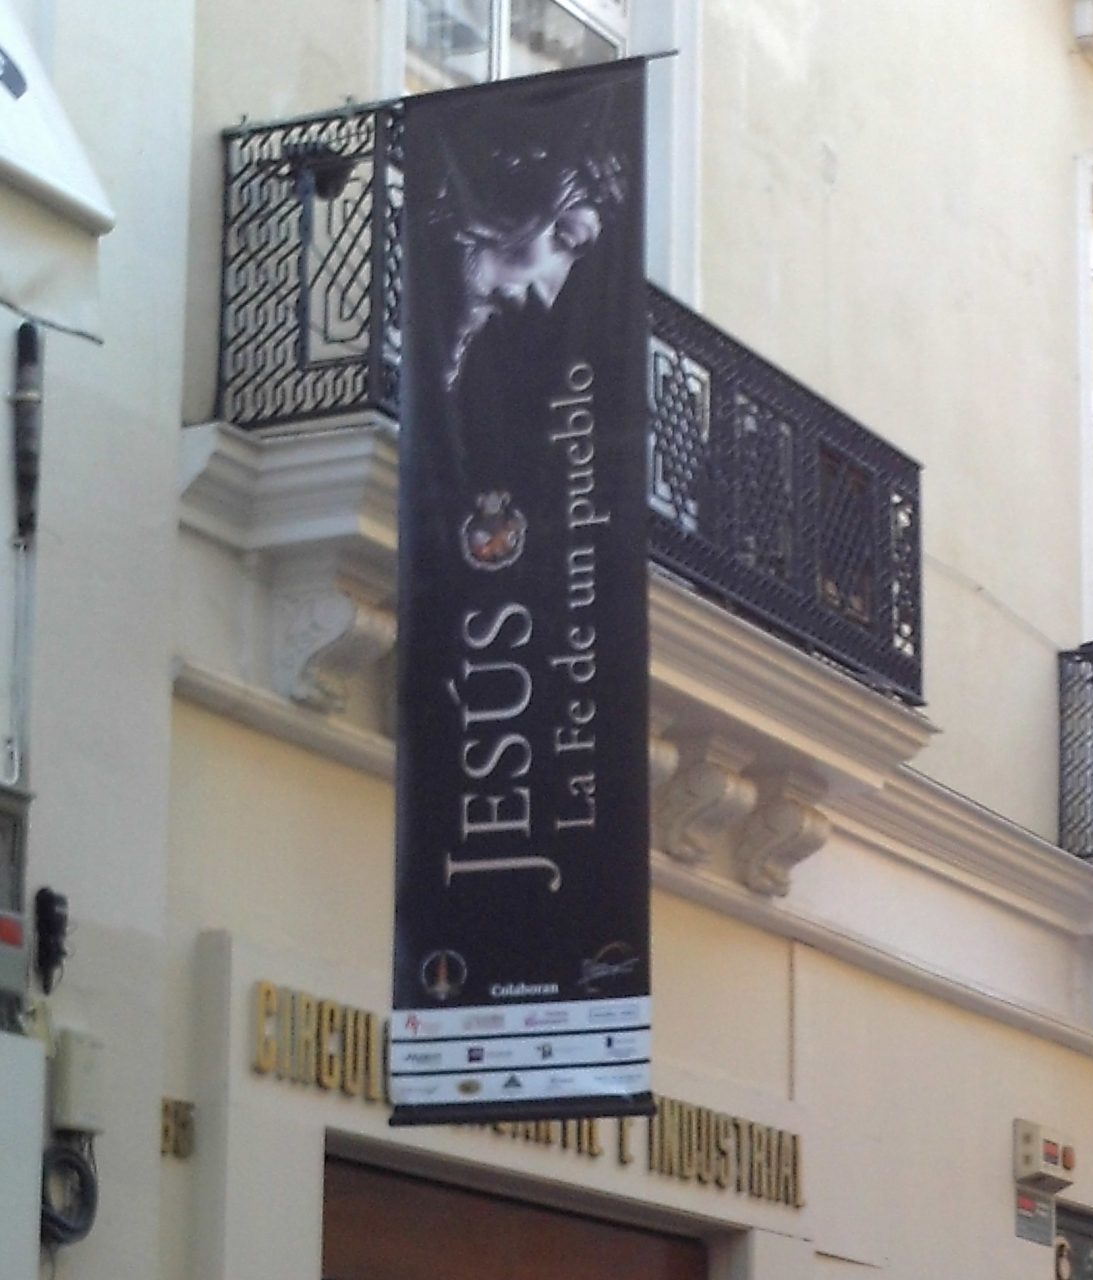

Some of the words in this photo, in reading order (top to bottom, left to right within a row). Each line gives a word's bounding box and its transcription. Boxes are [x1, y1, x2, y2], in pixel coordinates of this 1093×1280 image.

[551, 362, 610, 529] pueblo
[568, 546, 596, 609] un
[551, 626, 596, 684] de
[445, 602, 562, 893] JESÚS
[555, 699, 596, 753] Fe
[555, 774, 596, 831] La
[490, 982, 559, 998] Colaboran
[255, 980, 392, 1106] CIRCUL
[648, 1093, 805, 1209] INDUSTRIAL
